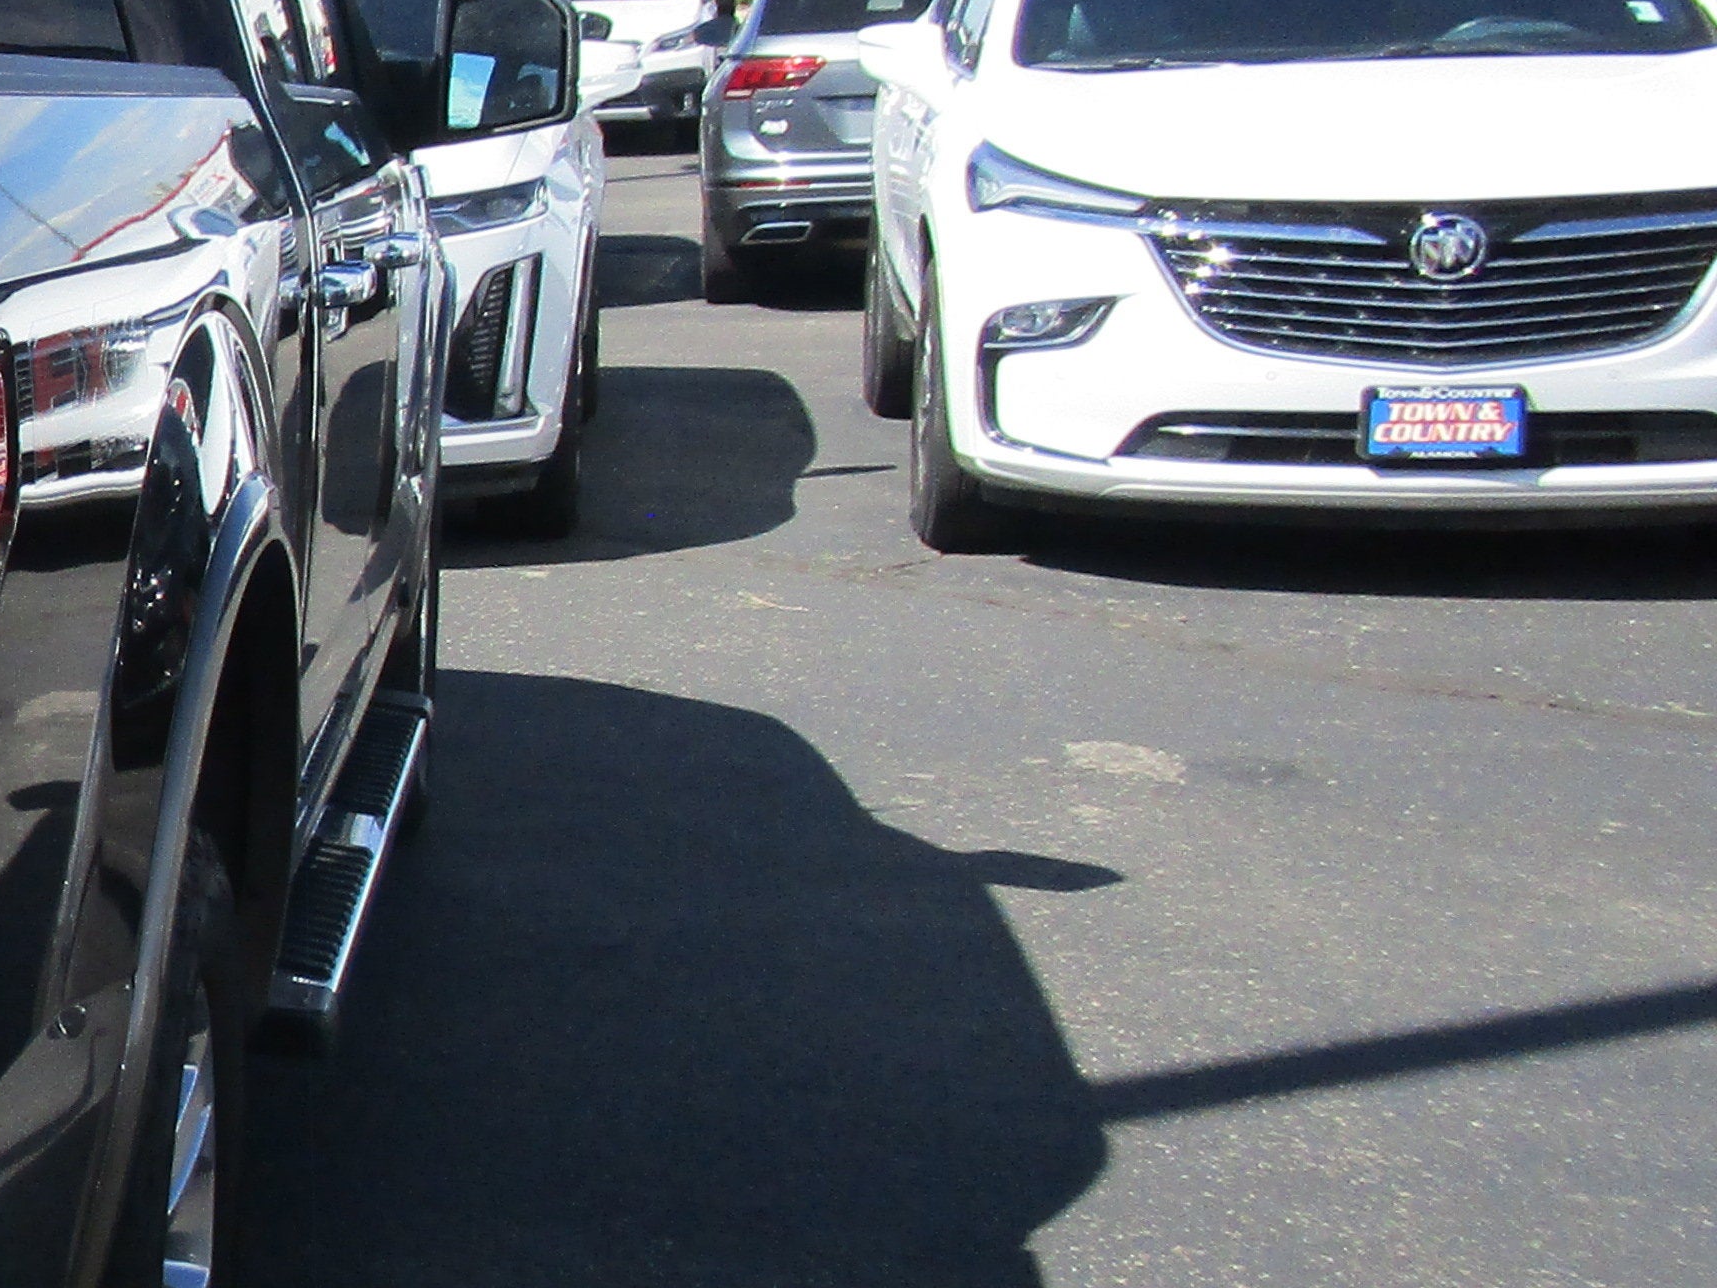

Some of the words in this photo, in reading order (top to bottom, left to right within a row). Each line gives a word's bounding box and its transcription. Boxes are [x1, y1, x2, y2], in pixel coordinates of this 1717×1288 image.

[1388, 400, 1476, 422] TOWN
[1476, 400, 1505, 422] &
[1373, 420, 1516, 444] COUNTRY
